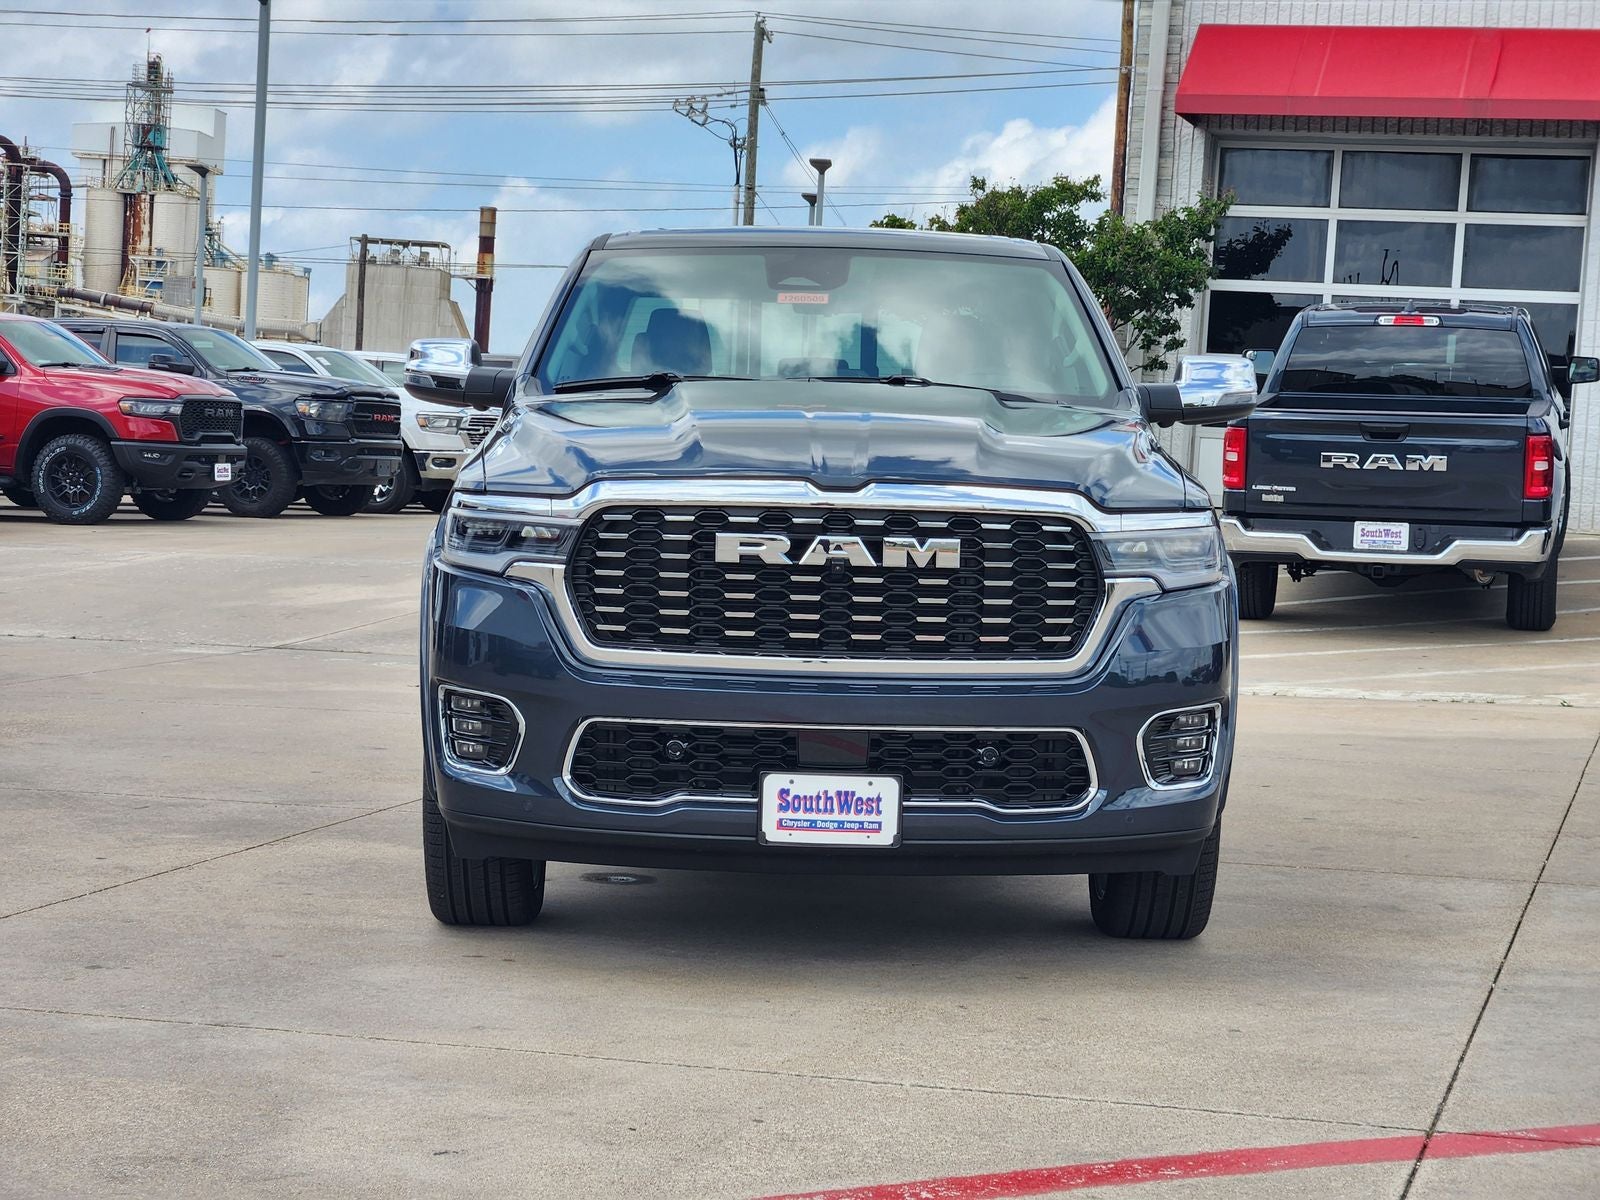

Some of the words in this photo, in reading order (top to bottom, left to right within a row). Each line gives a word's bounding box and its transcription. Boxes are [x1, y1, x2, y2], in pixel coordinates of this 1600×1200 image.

[204, 408, 234, 418] RAM
[373, 414, 394, 422] RAM
[1320, 452, 1447, 471] RAM
[1360, 528, 1402, 539] SouthWest
[715, 532, 961, 569] RAM
[777, 787, 883, 817] SouthWest
[782, 819, 811, 830] Chrysler
[816, 820, 838, 830] Dodge
[843, 821, 860, 830] Jeep
[863, 821, 879, 830] Ram
